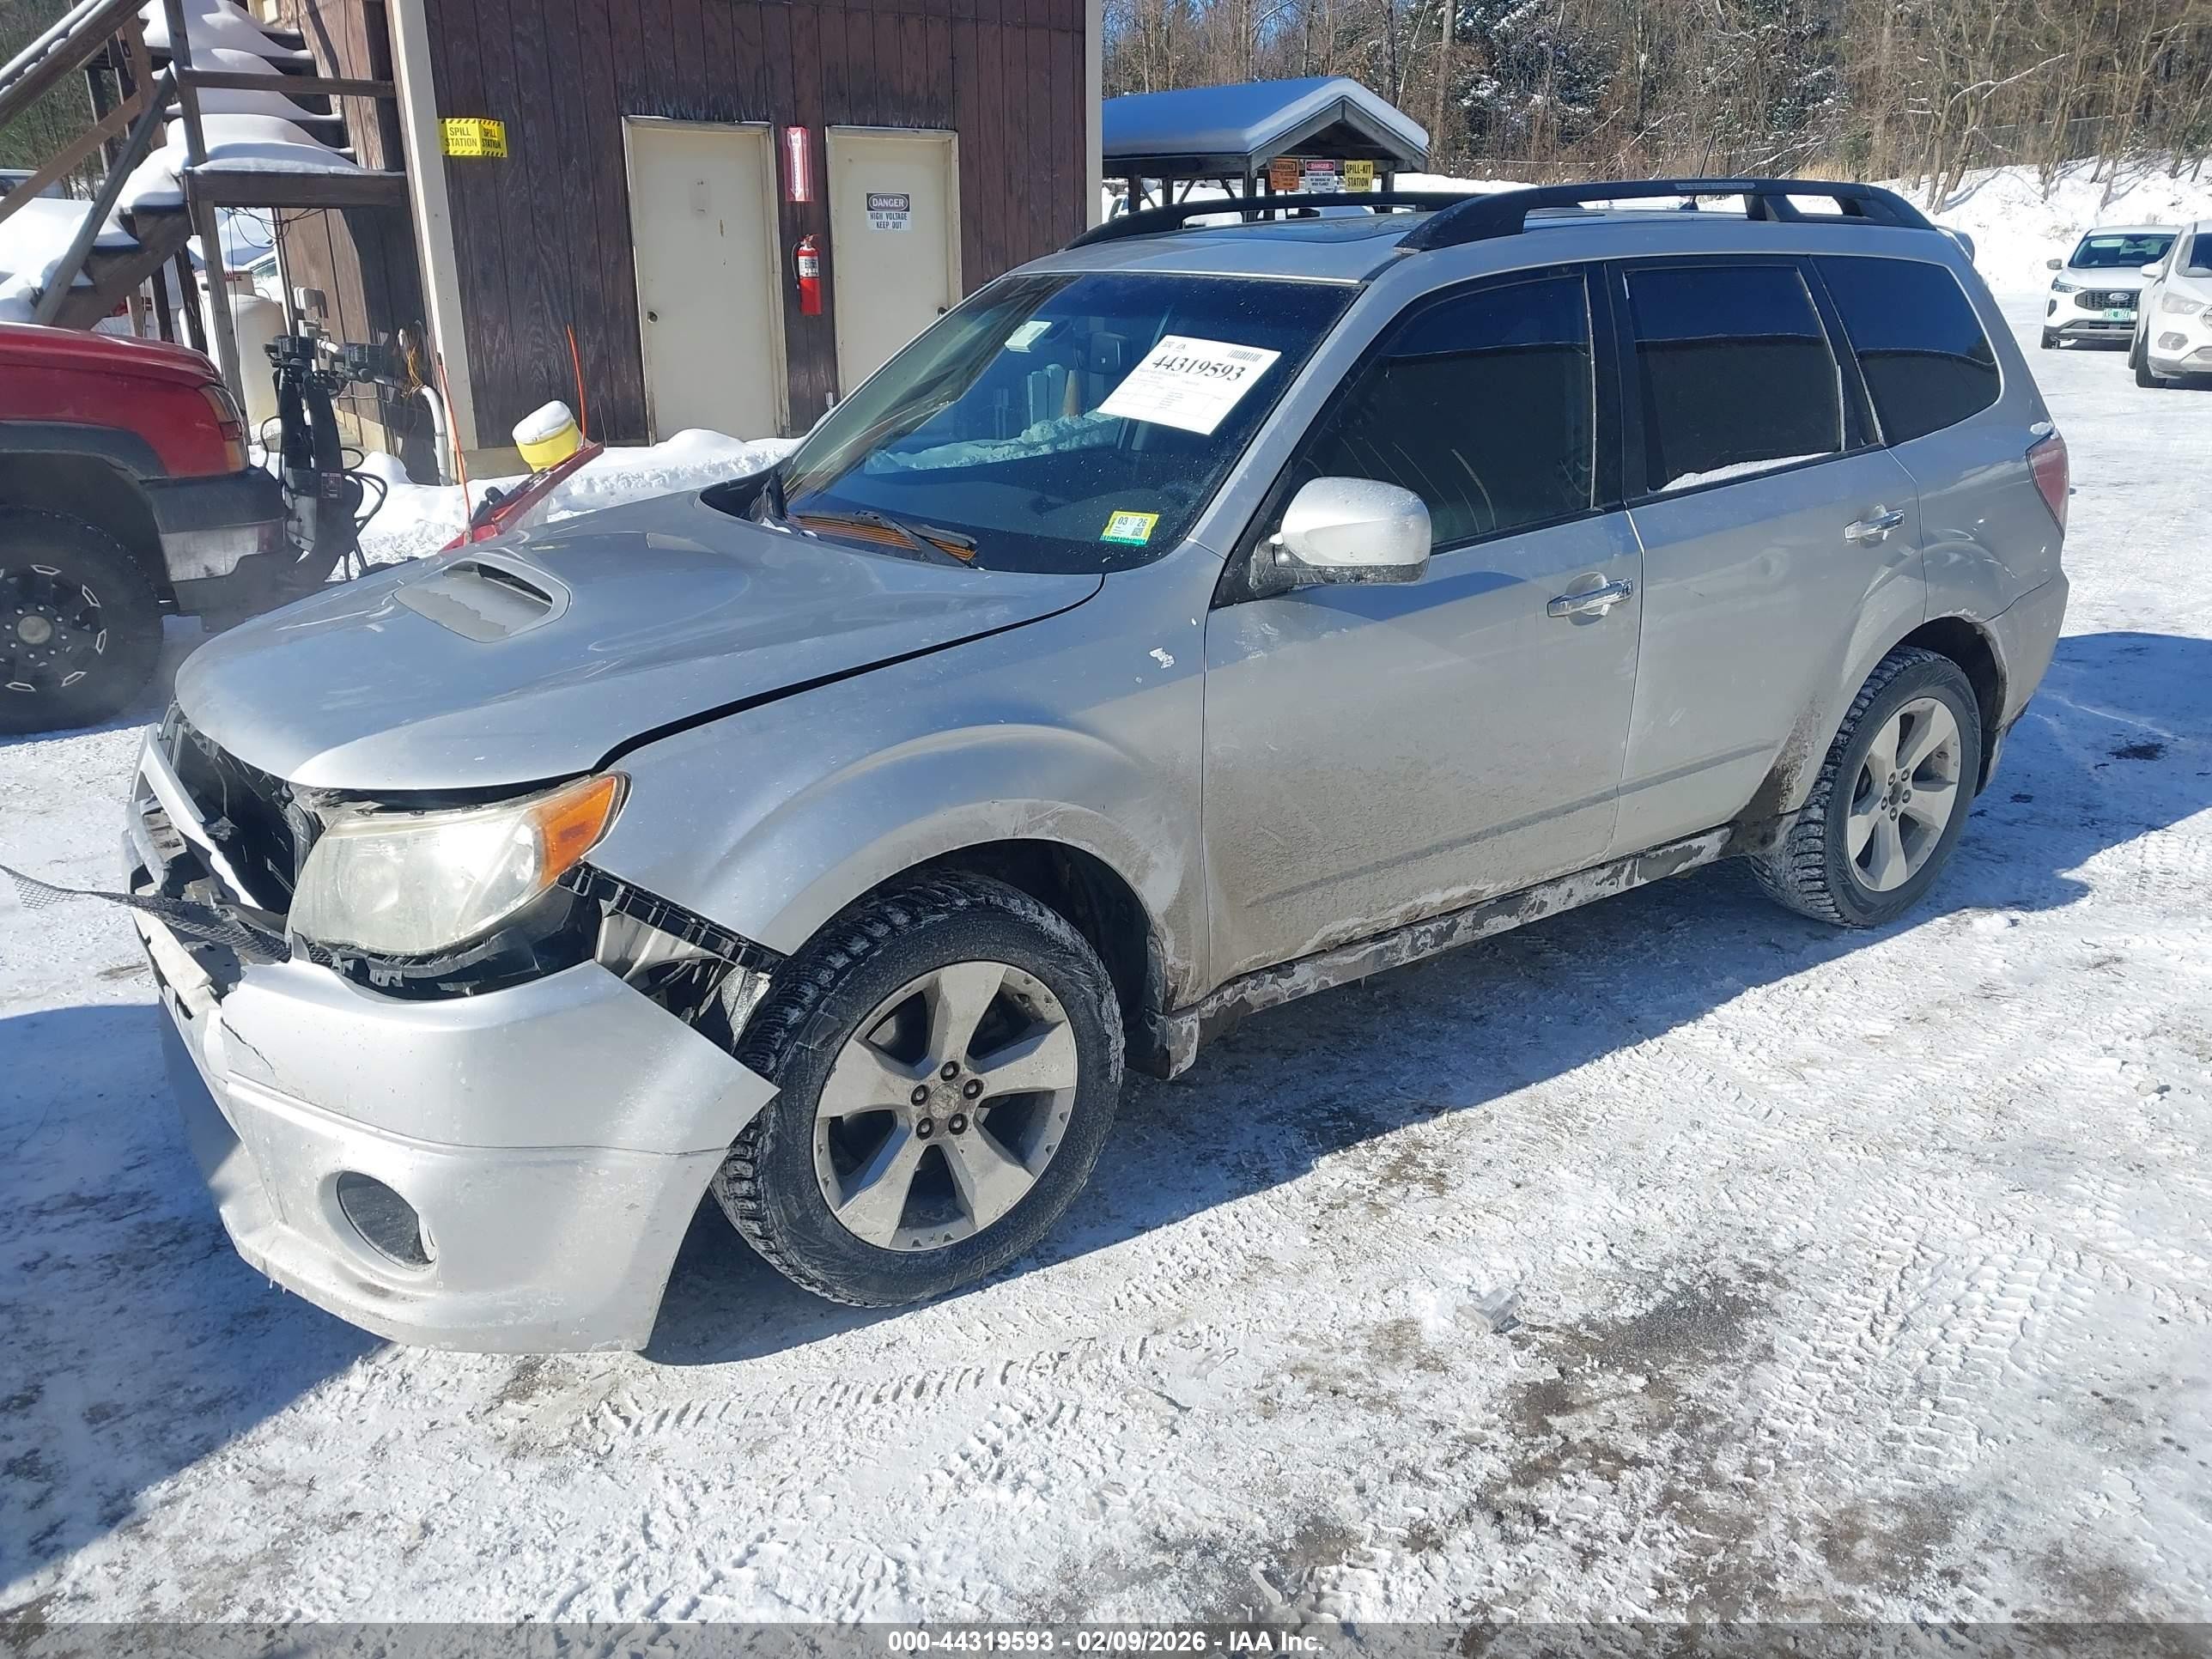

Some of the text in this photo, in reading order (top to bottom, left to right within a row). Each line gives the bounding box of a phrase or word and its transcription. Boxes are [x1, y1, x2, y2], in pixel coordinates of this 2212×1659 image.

[449, 126, 471, 137] SPILL
[483, 128, 497, 138] SPILL
[445, 137, 477, 147] STATION
[482, 137, 501, 149] STATION
[1346, 164, 1371, 174] SPILL-KIT
[1347, 177, 1370, 187] STATION
[872, 198, 904, 208] DANGER
[870, 212, 908, 221] HIGH VOLTAGE
[876, 221, 902, 229] KEEP OUT
[1152, 354, 1246, 381] 44319593
[1117, 516, 1148, 526] 03 26
